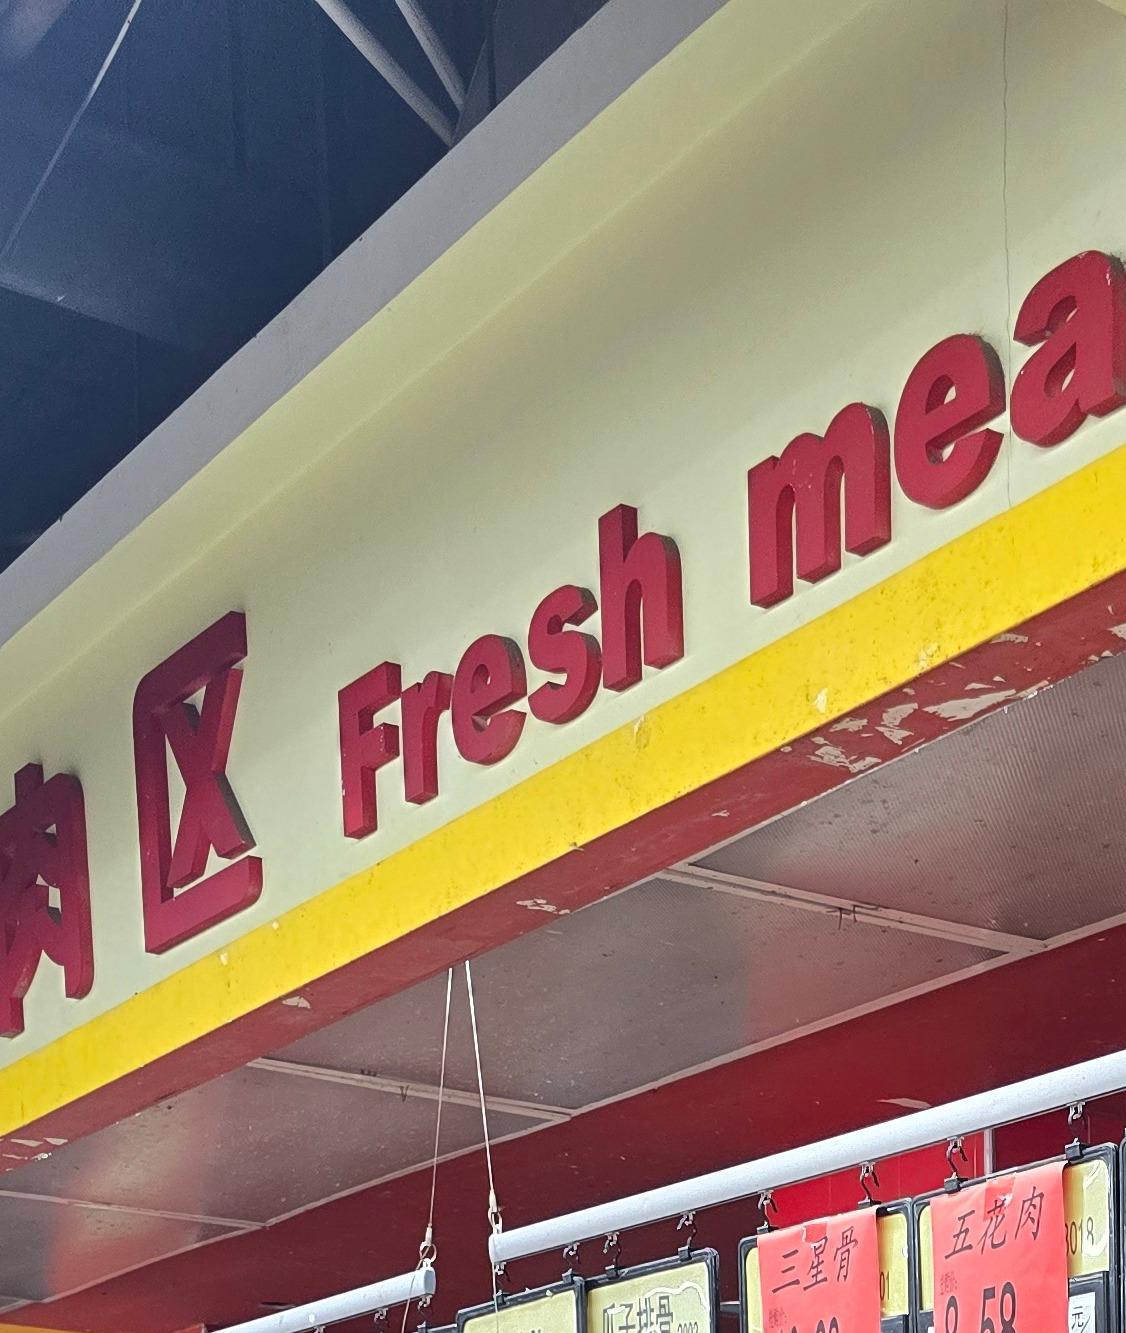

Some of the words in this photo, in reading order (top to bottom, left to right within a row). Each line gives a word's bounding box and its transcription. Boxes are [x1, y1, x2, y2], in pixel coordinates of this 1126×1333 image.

[338, 503, 684, 839] Fresh
[772, 1226, 859, 1294] 三星骨
[944, 1185, 1045, 1260] 五花肉
